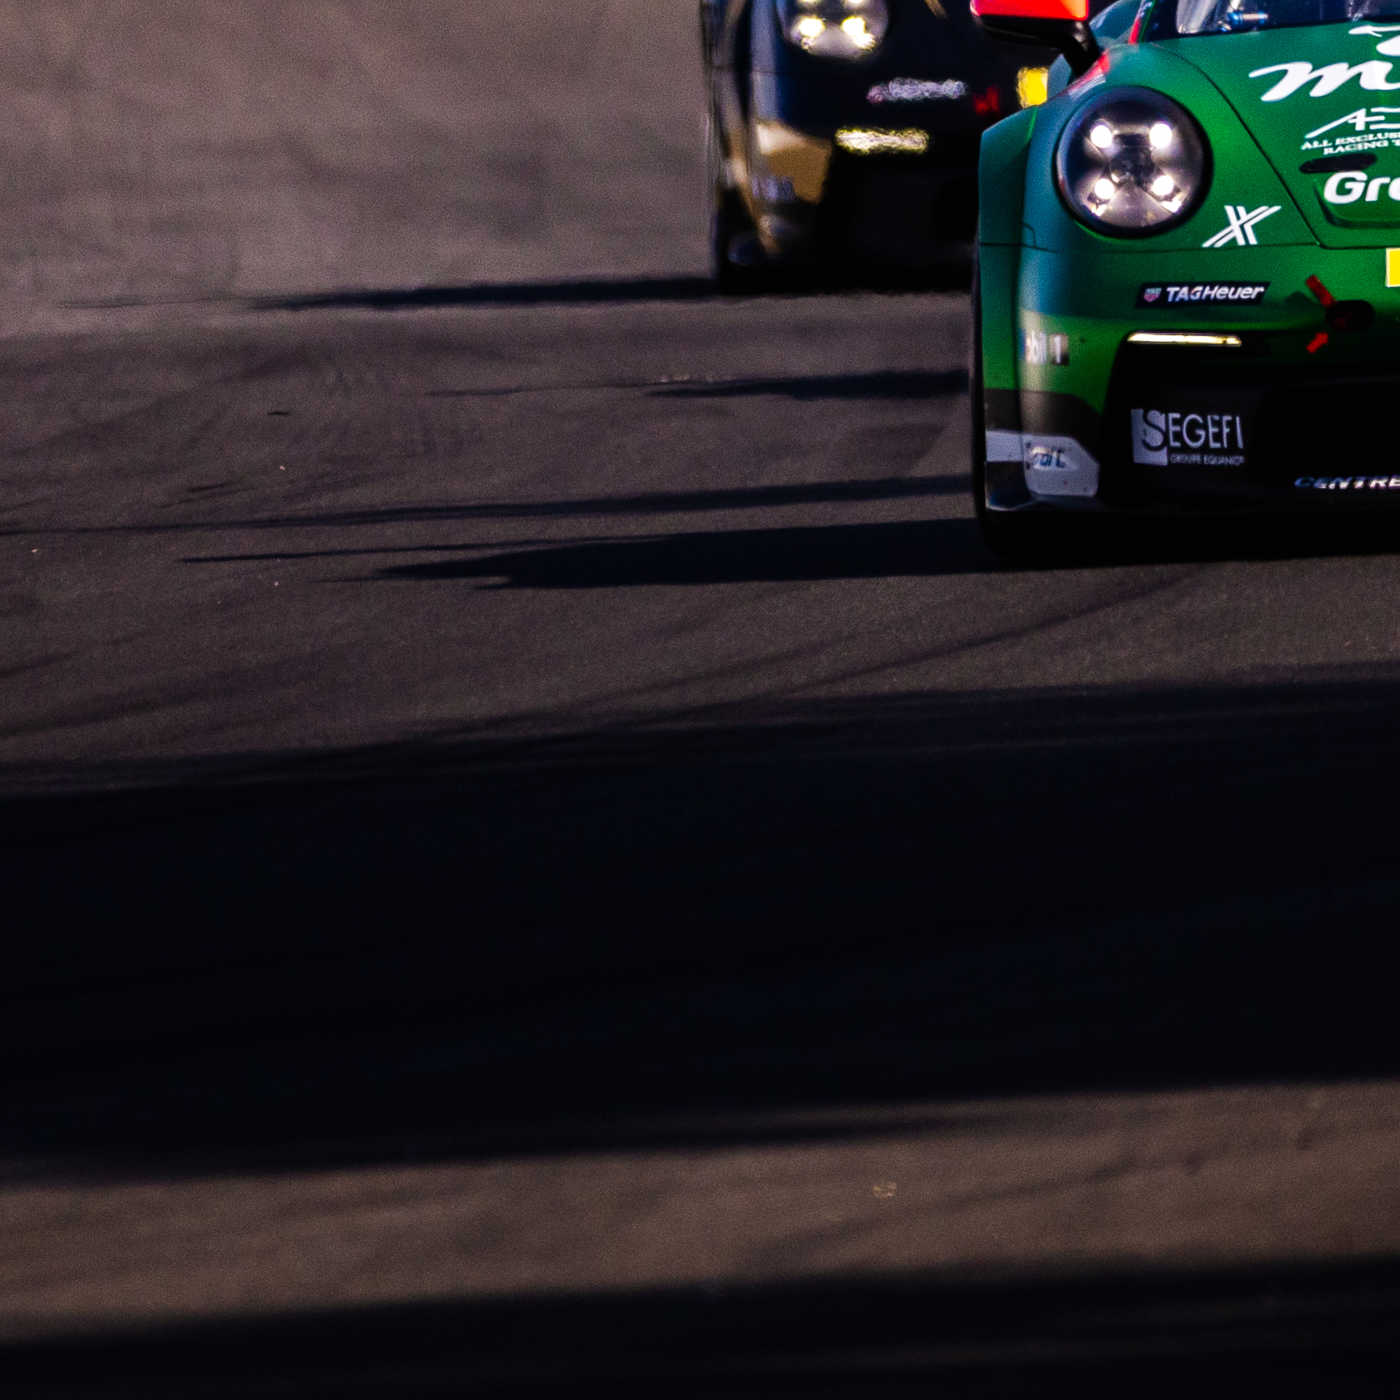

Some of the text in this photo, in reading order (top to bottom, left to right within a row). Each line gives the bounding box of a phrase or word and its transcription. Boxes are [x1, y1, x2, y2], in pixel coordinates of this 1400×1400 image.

[1301, 139, 1333, 150] ALL
[1323, 139, 1389, 155] RACING
[1141, 408, 1244, 451] SEGEFI
